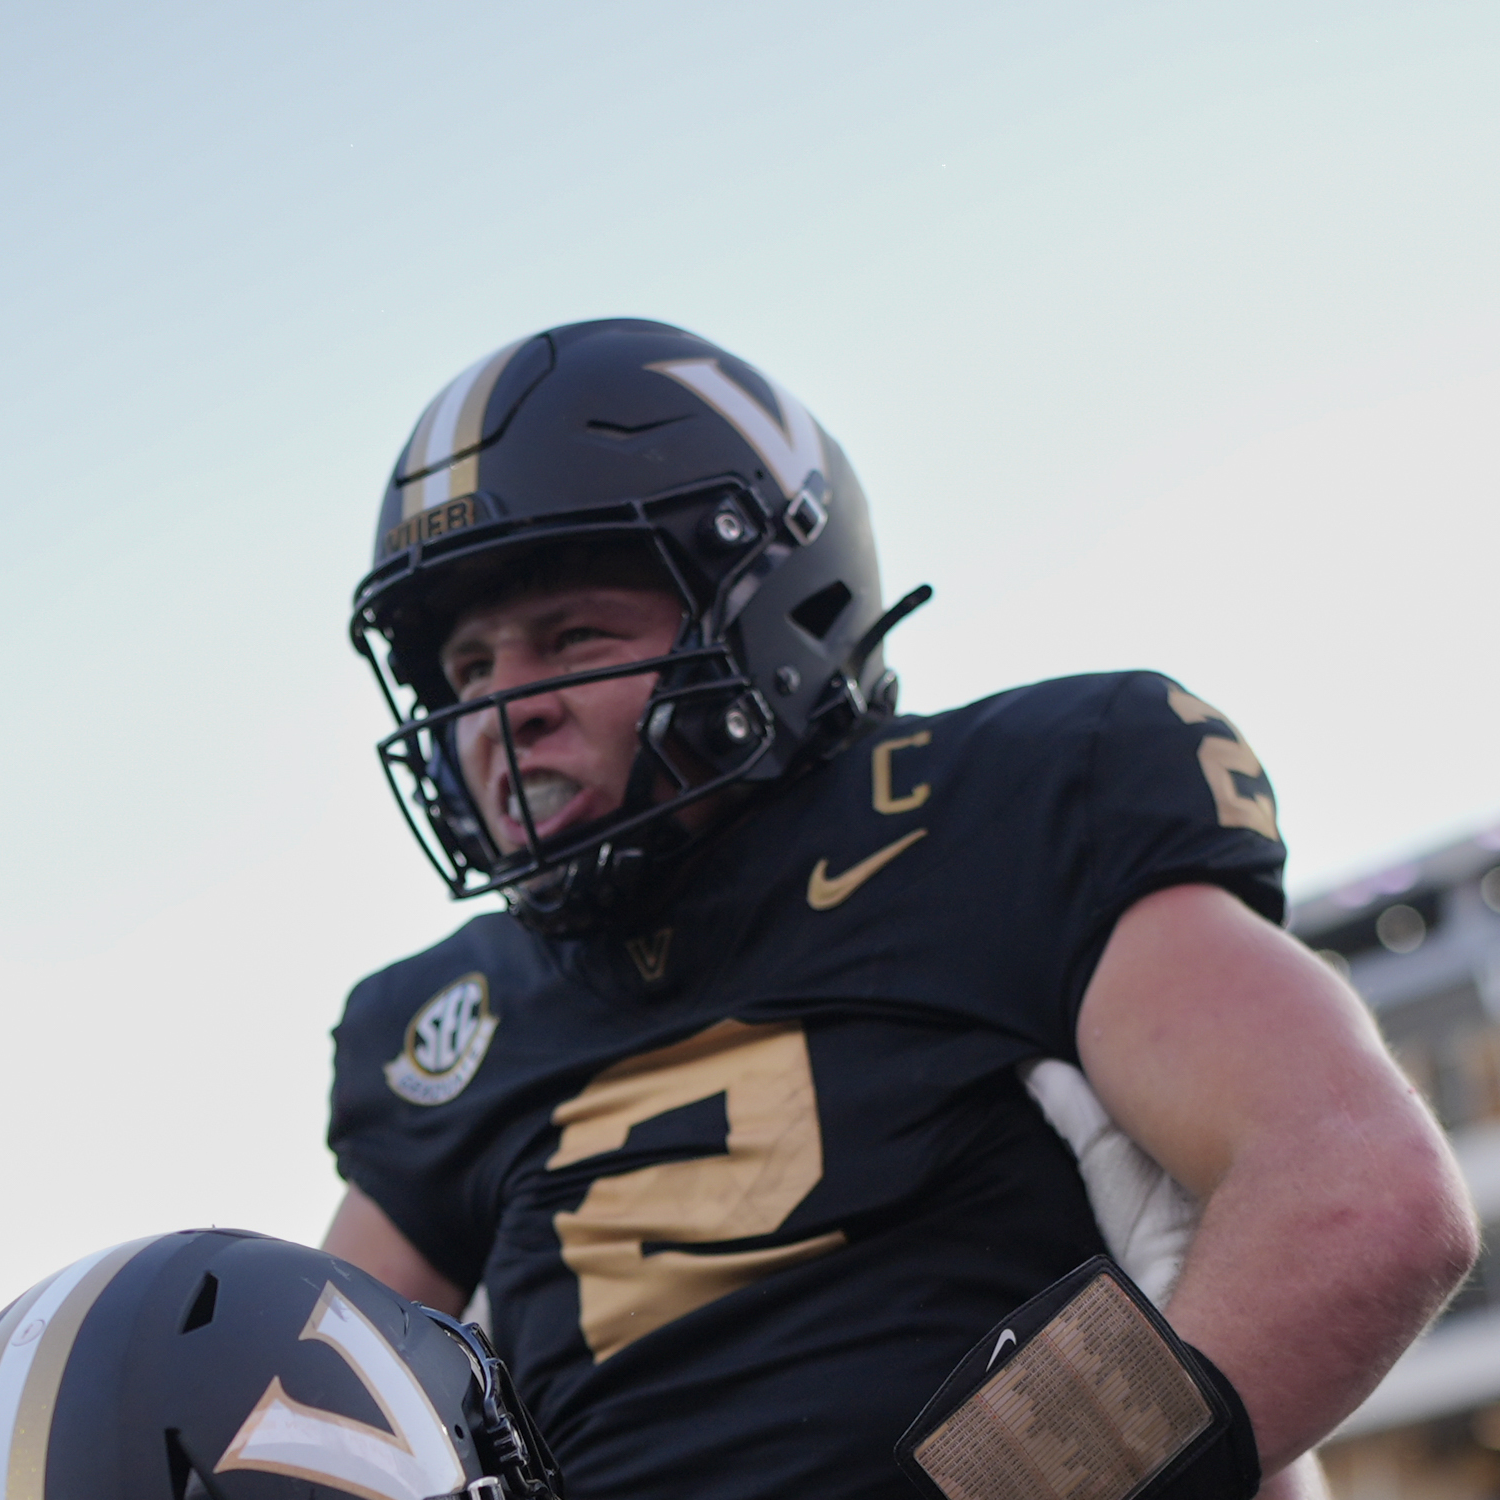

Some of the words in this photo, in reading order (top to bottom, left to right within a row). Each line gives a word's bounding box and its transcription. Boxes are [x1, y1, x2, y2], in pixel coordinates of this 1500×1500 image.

[872, 731, 933, 816] C
[1167, 685, 1279, 842] 2
[546, 1018, 849, 1366] 2
